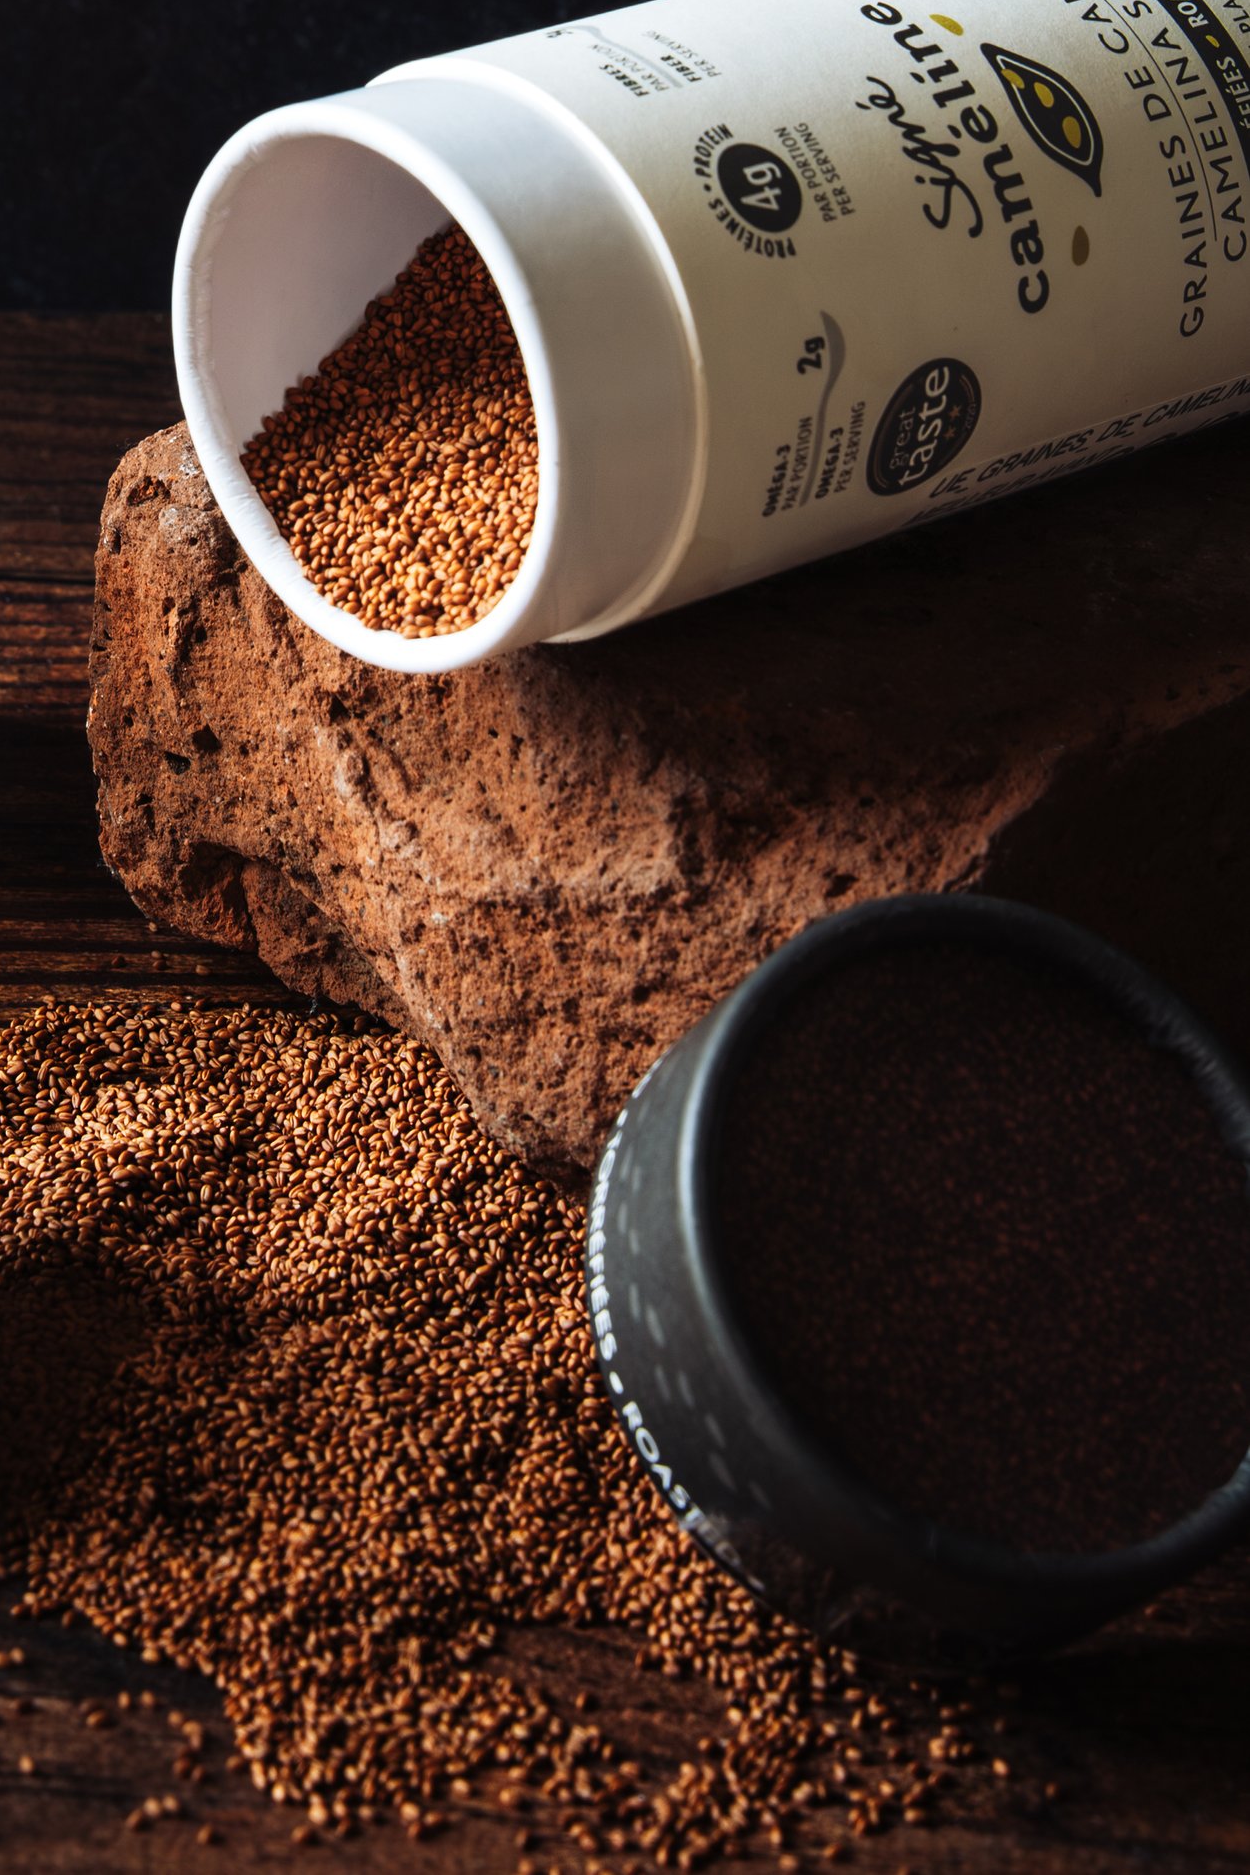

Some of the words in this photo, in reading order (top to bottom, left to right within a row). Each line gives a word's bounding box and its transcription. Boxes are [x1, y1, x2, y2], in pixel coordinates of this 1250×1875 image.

[598, 63, 650, 98] FIBRES
[659, 54, 703, 84] FIBER
[1124, 65, 1173, 123] DE
[693, 122, 735, 180] PROTEIN
[773, 125, 823, 191] PORTION
[793, 122, 842, 186] SERVING
[854, 76, 985, 239] Signé
[860, 1, 1051, 315] caméline
[1151, 27, 1248, 263] CAMELINA
[740, 161, 784, 212] 4g
[813, 192, 839, 224] PAR
[831, 187, 857, 218] PER
[1159, 133, 1209, 339] GRAINES
[796, 336, 826, 375] 2g
[789, 415, 813, 483] PORTION
[843, 400, 866, 467] SERVING
[888, 405, 917, 471] great
[899, 365, 951, 486] taste
[976, 427, 1095, 483] GRAINES
[1095, 412, 1143, 444] DE
[834, 465, 853, 494] PER
